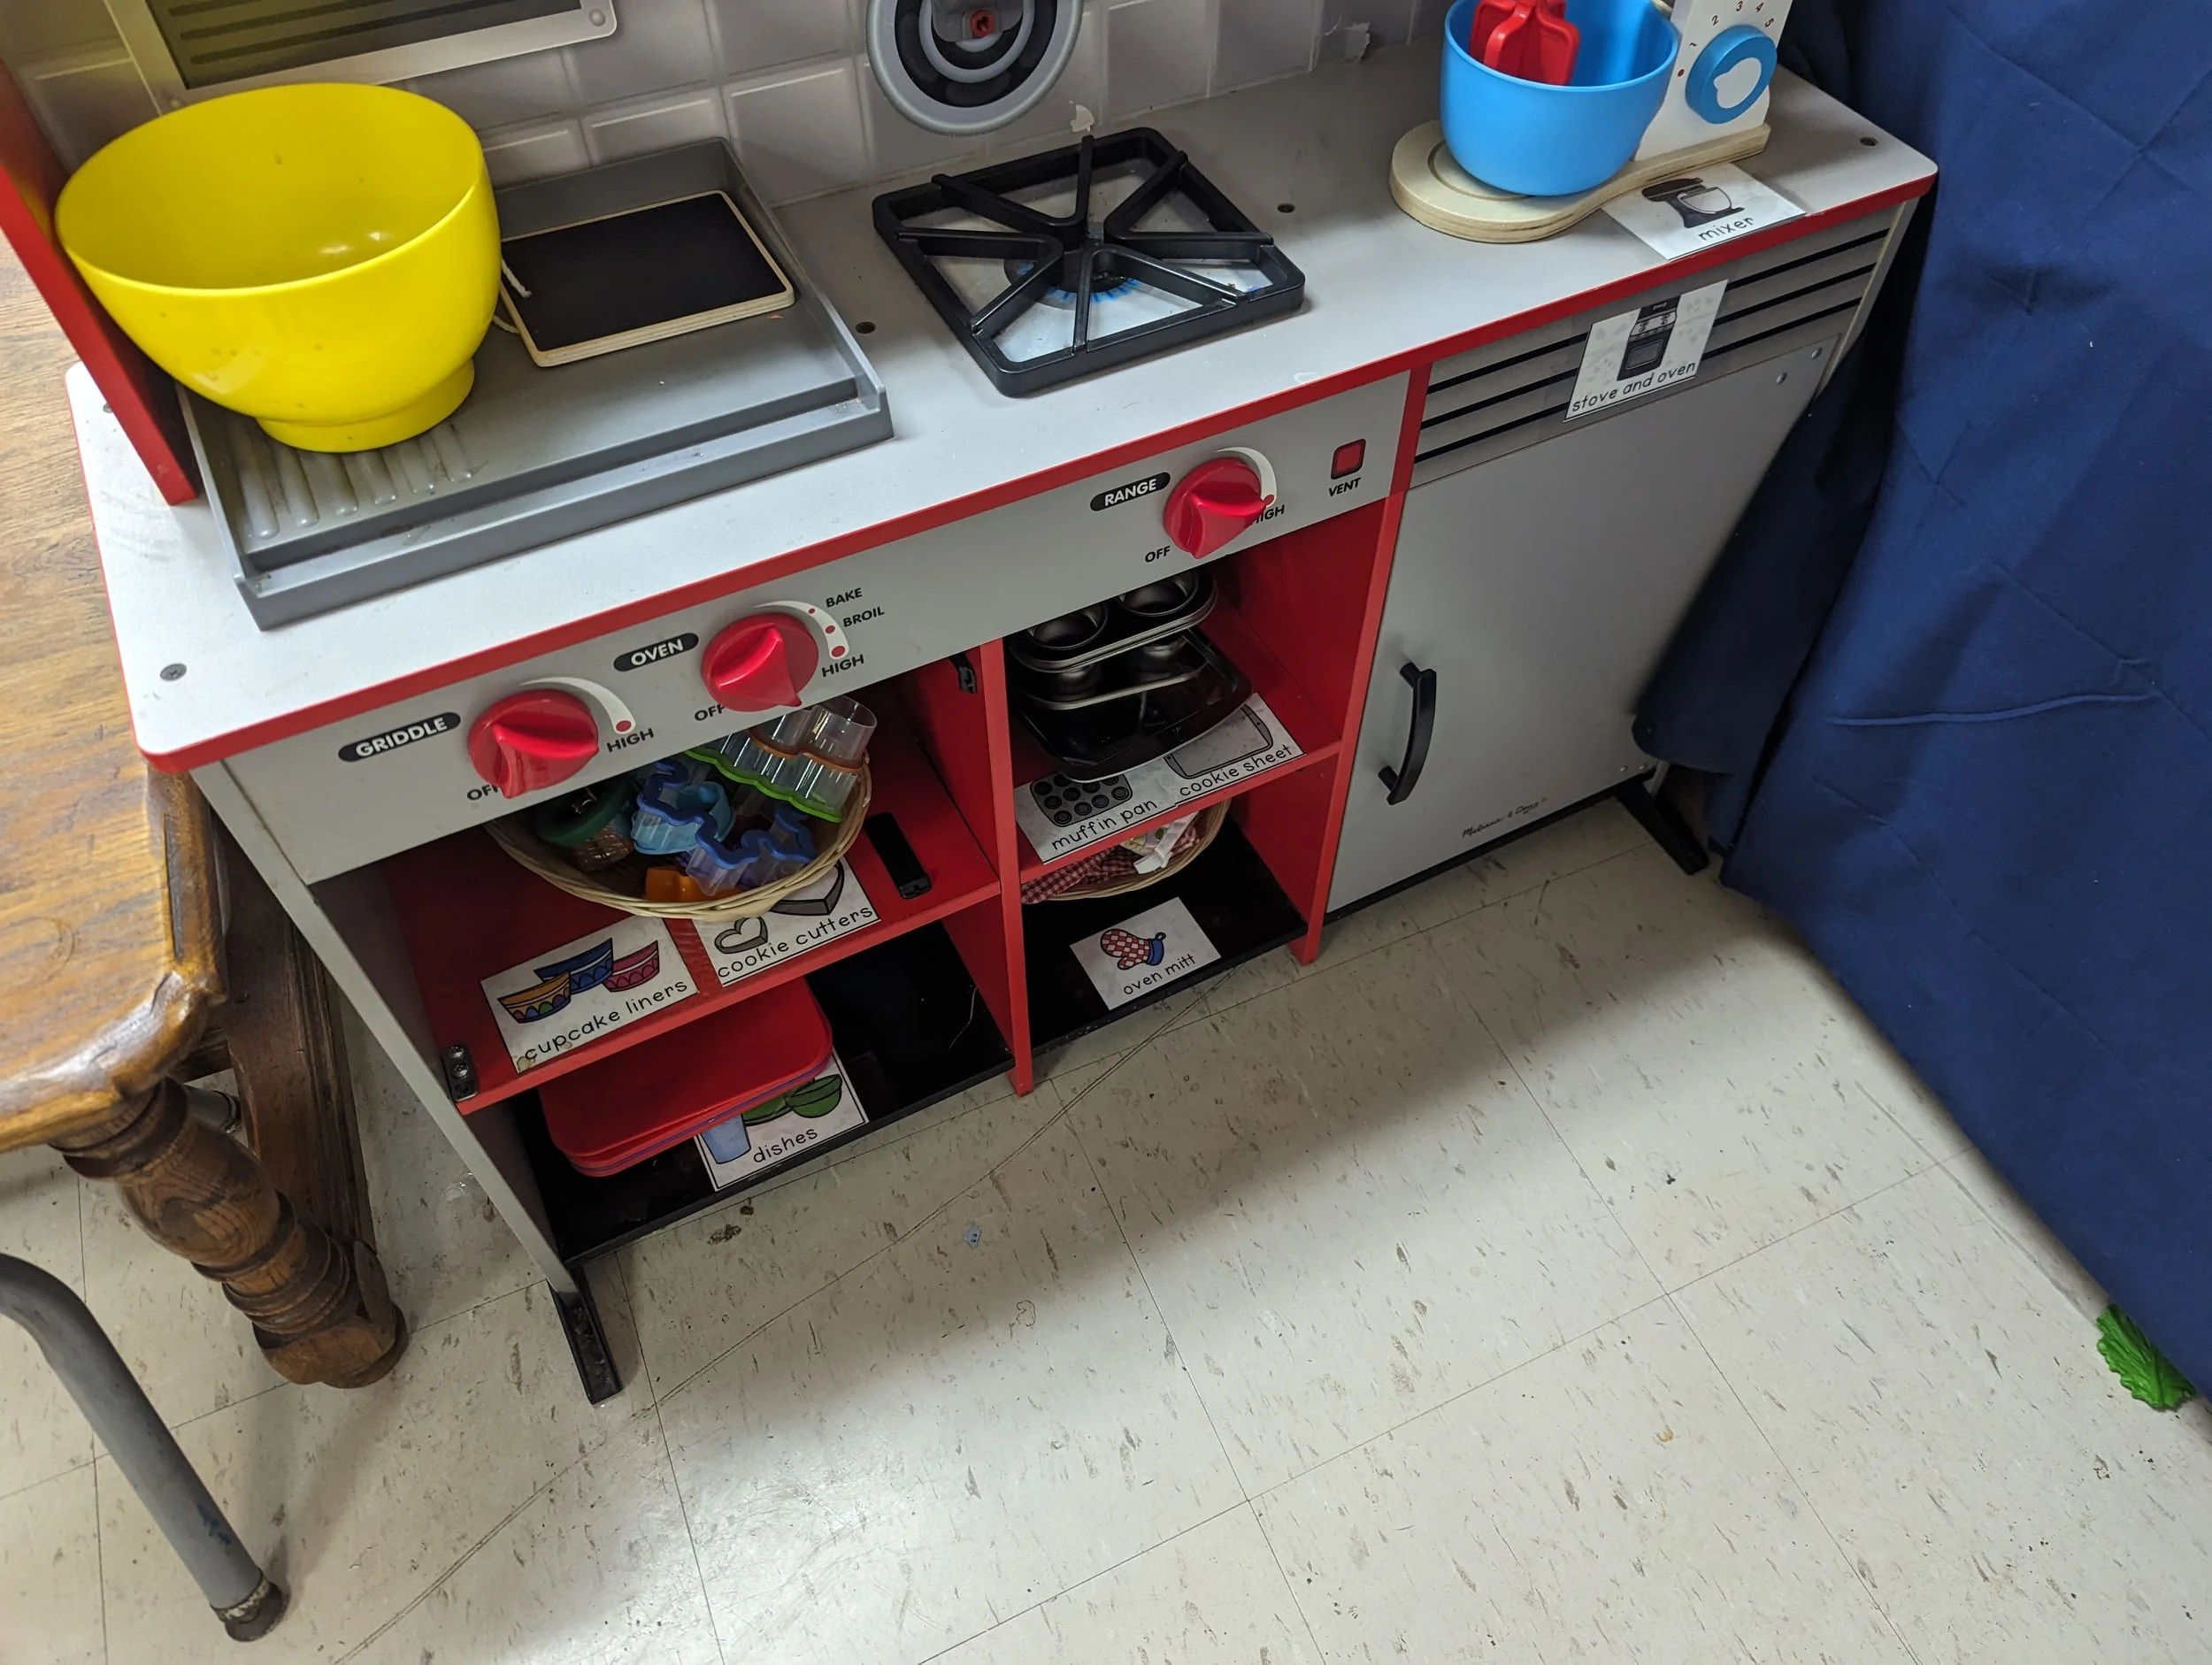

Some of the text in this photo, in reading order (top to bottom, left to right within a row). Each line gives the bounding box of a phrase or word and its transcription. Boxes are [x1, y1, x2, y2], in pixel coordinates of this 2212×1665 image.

[1711, 15, 1719, 26] 2
[1735, 1, 1744, 12] 3
[1755, 2, 1764, 12] 4
[1764, 18, 1775, 27] 5
[1698, 216, 1754, 242] mixer
[1571, 362, 1696, 412] stove and oven
[1103, 478, 1157, 508] RANGE
[1328, 477, 1362, 497] VENT
[1256, 504, 1286, 524] IGH
[1144, 545, 1171, 564] OFF
[825, 587, 864, 609] BAKE
[842, 606, 886, 628] BROIL
[630, 638, 685, 666] OVEN
[821, 654, 865, 678] HIGH
[355, 716, 449, 757] GRIDDLE
[606, 728, 655, 753] HIGH
[1179, 743, 1294, 796] cookie sheet
[1051, 800, 1158, 851] muffin pan
[718, 905, 874, 978] cookie cutters
[1123, 953, 1196, 994] oven mitt
[524, 980, 688, 1060] cupcake liners
[753, 1128, 818, 1162] dishes
